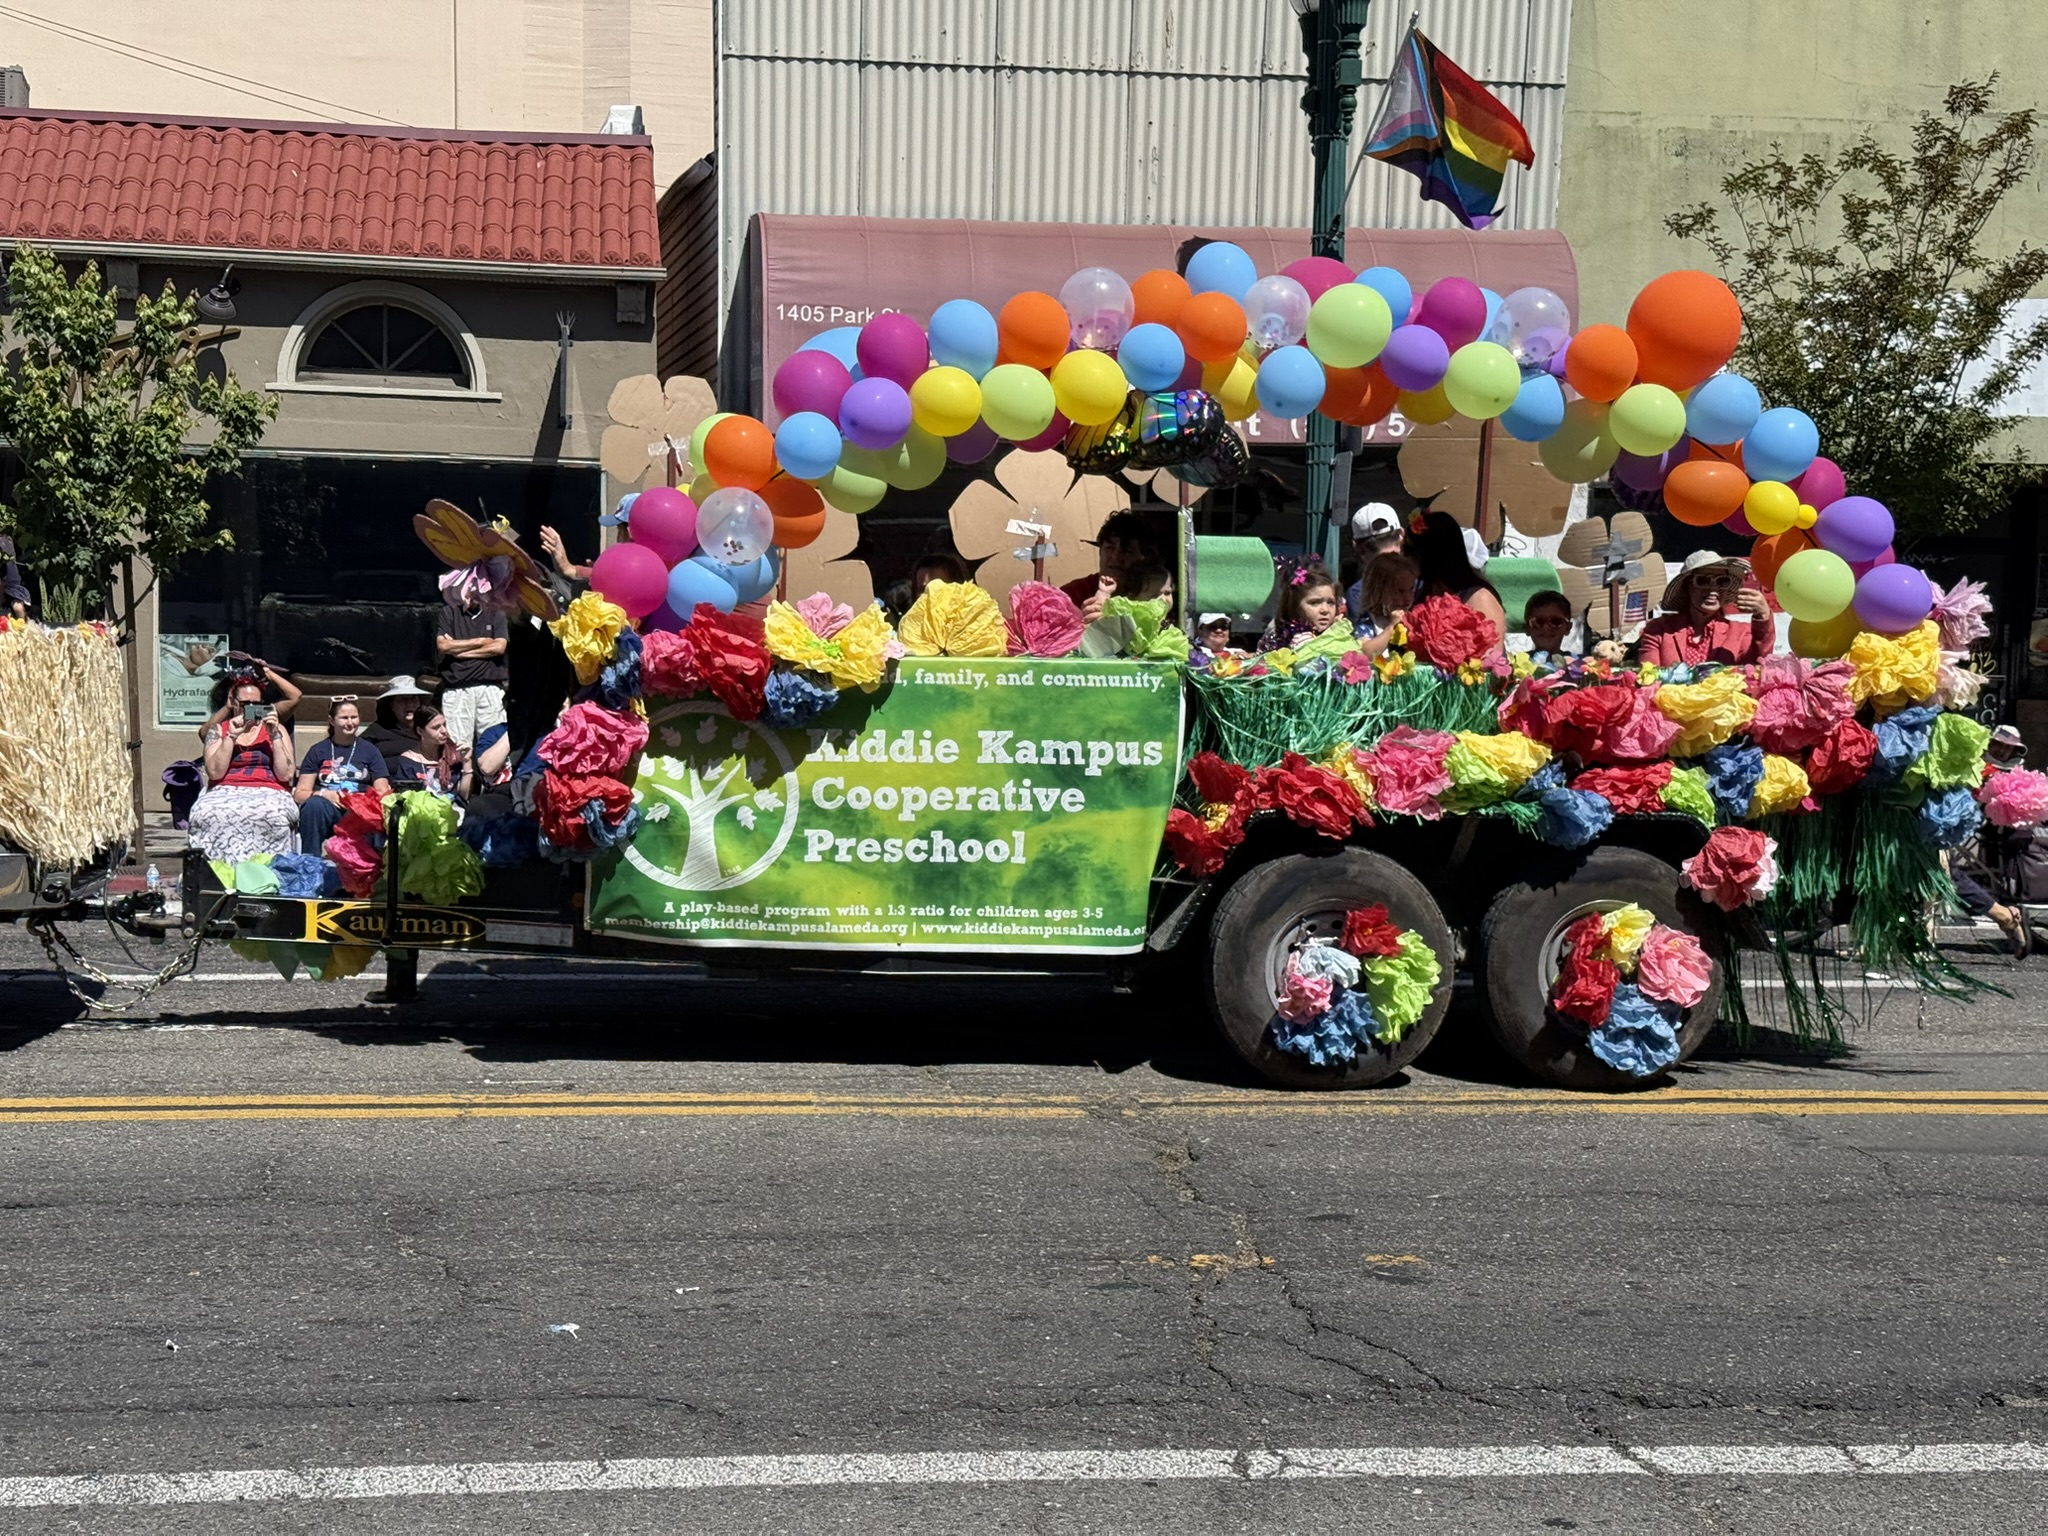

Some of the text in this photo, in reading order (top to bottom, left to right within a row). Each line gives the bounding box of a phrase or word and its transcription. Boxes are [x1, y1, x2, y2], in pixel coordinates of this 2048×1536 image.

[776, 304, 824, 322] 1405
[830, 306, 875, 323] Park
[914, 668, 989, 690] family,
[996, 669, 1035, 686] and
[1042, 671, 1165, 693] community.
[806, 729, 1163, 776] Kiddie Kampus
[812, 776, 1086, 821] Cooperative
[804, 829, 1027, 864] Preschool
[304, 898, 471, 945] Kauman
[664, 902, 1103, 921] A play-based program with a 1:3 ratio for children ages 3-5
[604, 917, 908, 936] membership@kiddiekampusalameda.org
[921, 922, 1146, 938] www.kiddiekampusalameda.or
